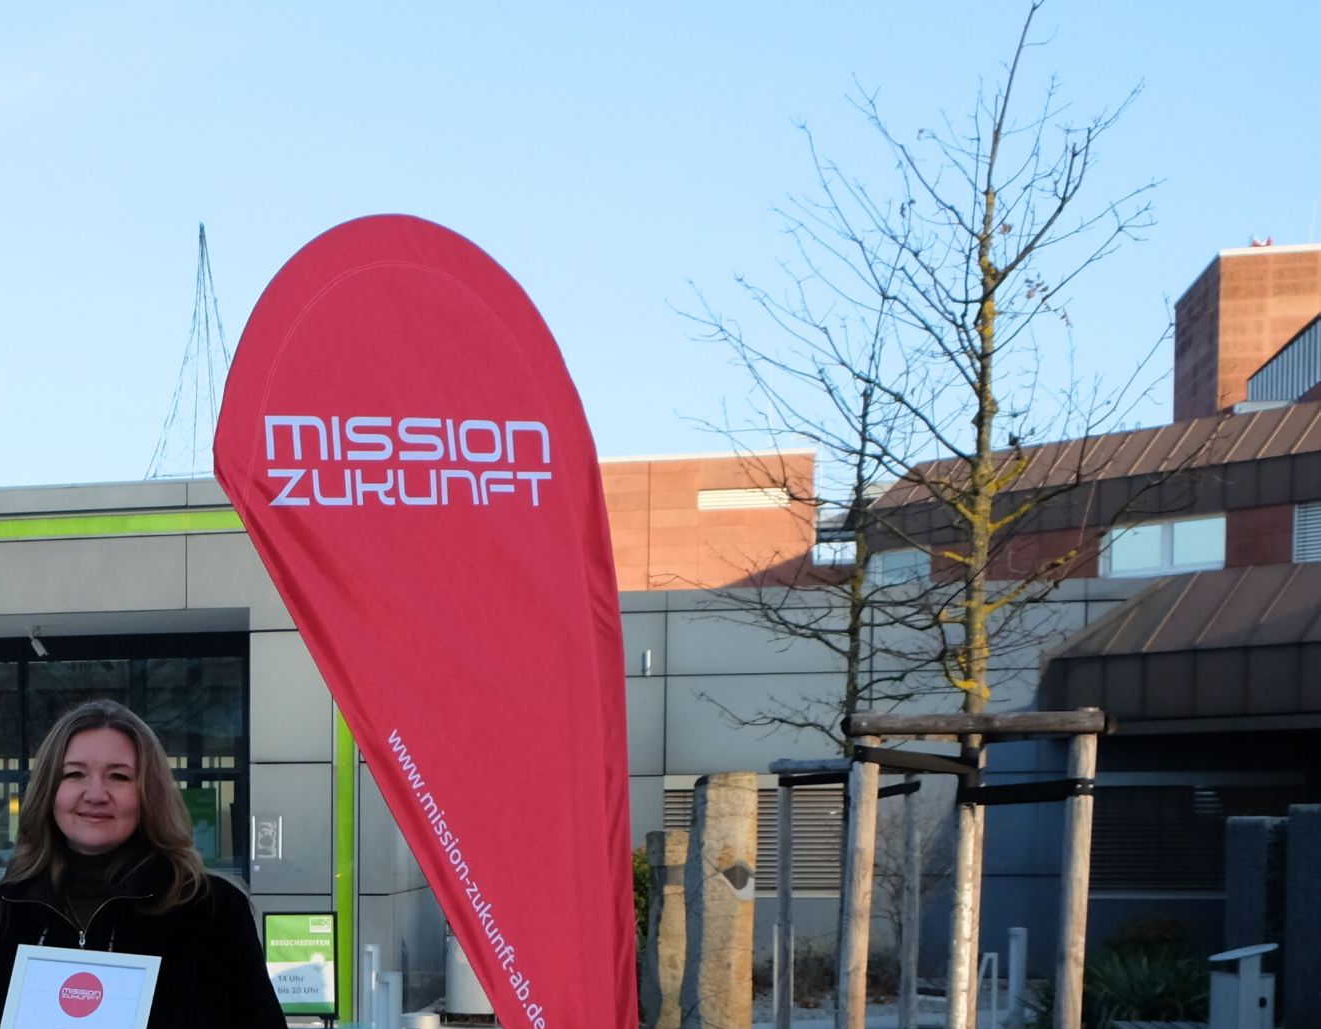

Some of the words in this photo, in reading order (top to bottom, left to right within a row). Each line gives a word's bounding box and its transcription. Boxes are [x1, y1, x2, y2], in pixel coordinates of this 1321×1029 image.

[265, 415, 550, 464] MISSION
[267, 469, 552, 506] ZUKUNFT
[277, 986, 290, 994] bis
[304, 986, 319, 994] Uhr
